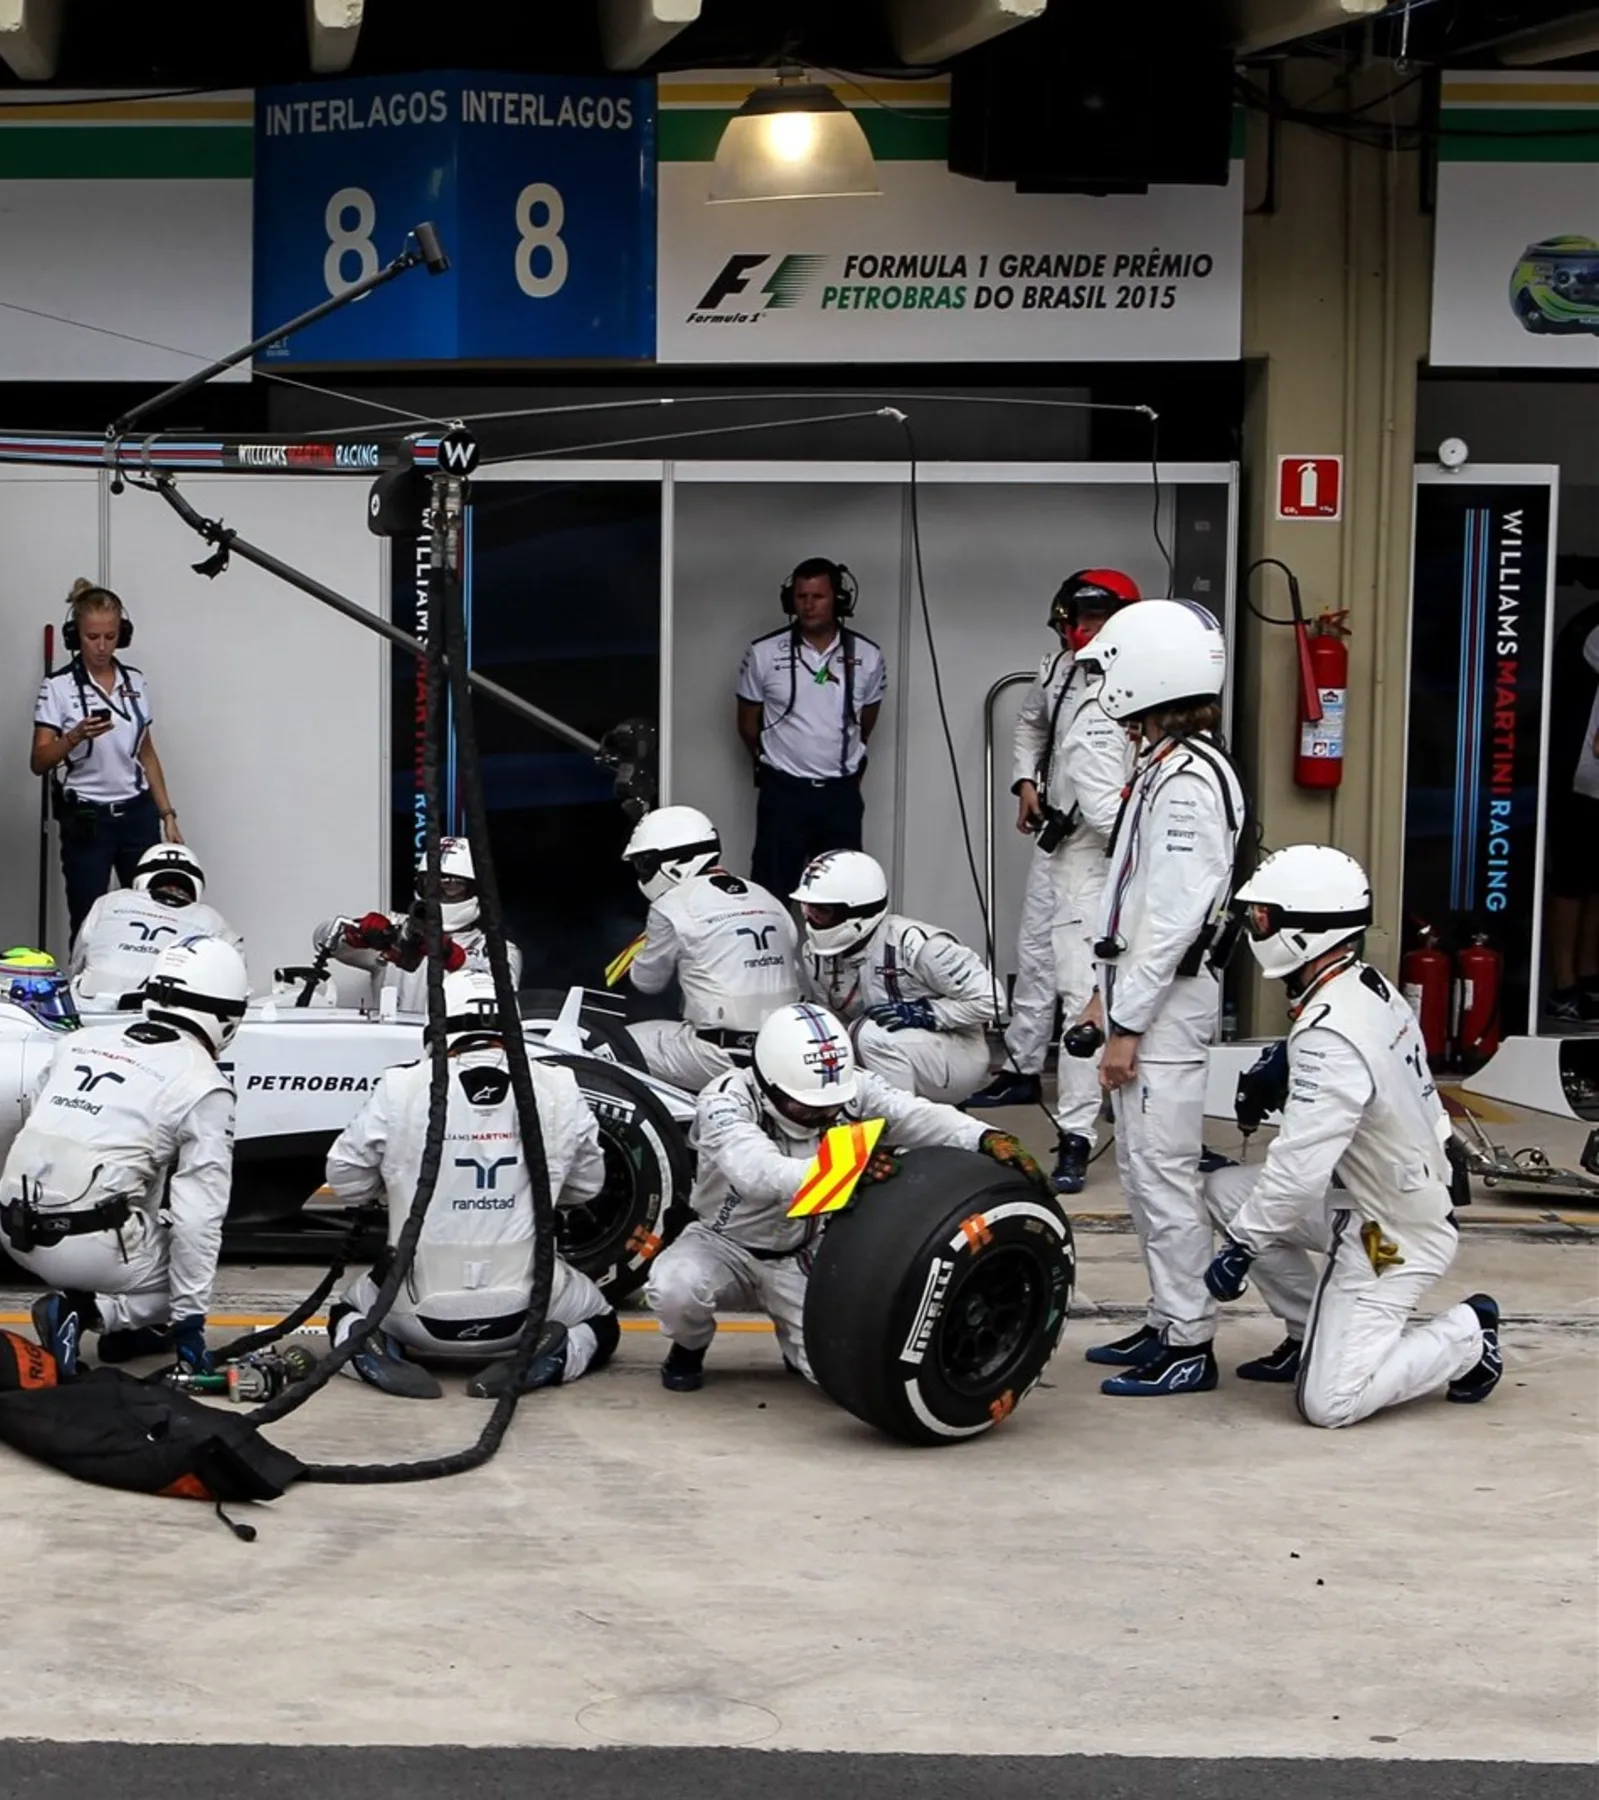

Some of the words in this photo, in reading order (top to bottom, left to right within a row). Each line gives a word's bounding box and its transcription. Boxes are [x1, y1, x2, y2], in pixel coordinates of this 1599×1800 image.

[266, 90, 448, 136] INTERLAGOS
[462, 90, 633, 129] INTERLAGOS
[324, 187, 380, 301] 8
[515, 183, 569, 297] 8
[843, 254, 967, 279] FORMULA
[977, 254, 988, 278] 1
[999, 254, 1105, 279] GRANDE
[1112, 247, 1213, 278] PRÊMIO
[821, 285, 967, 309] PETROBRAS
[973, 286, 1015, 309] DO
[1021, 285, 1108, 309] BRASIL
[1115, 285, 1176, 309] 2015
[685, 312, 749, 323] Formula
[444, 440, 476, 468] W
[452, 1194, 516, 1210] randstad
[900, 1257, 955, 1365] PIRELLI
